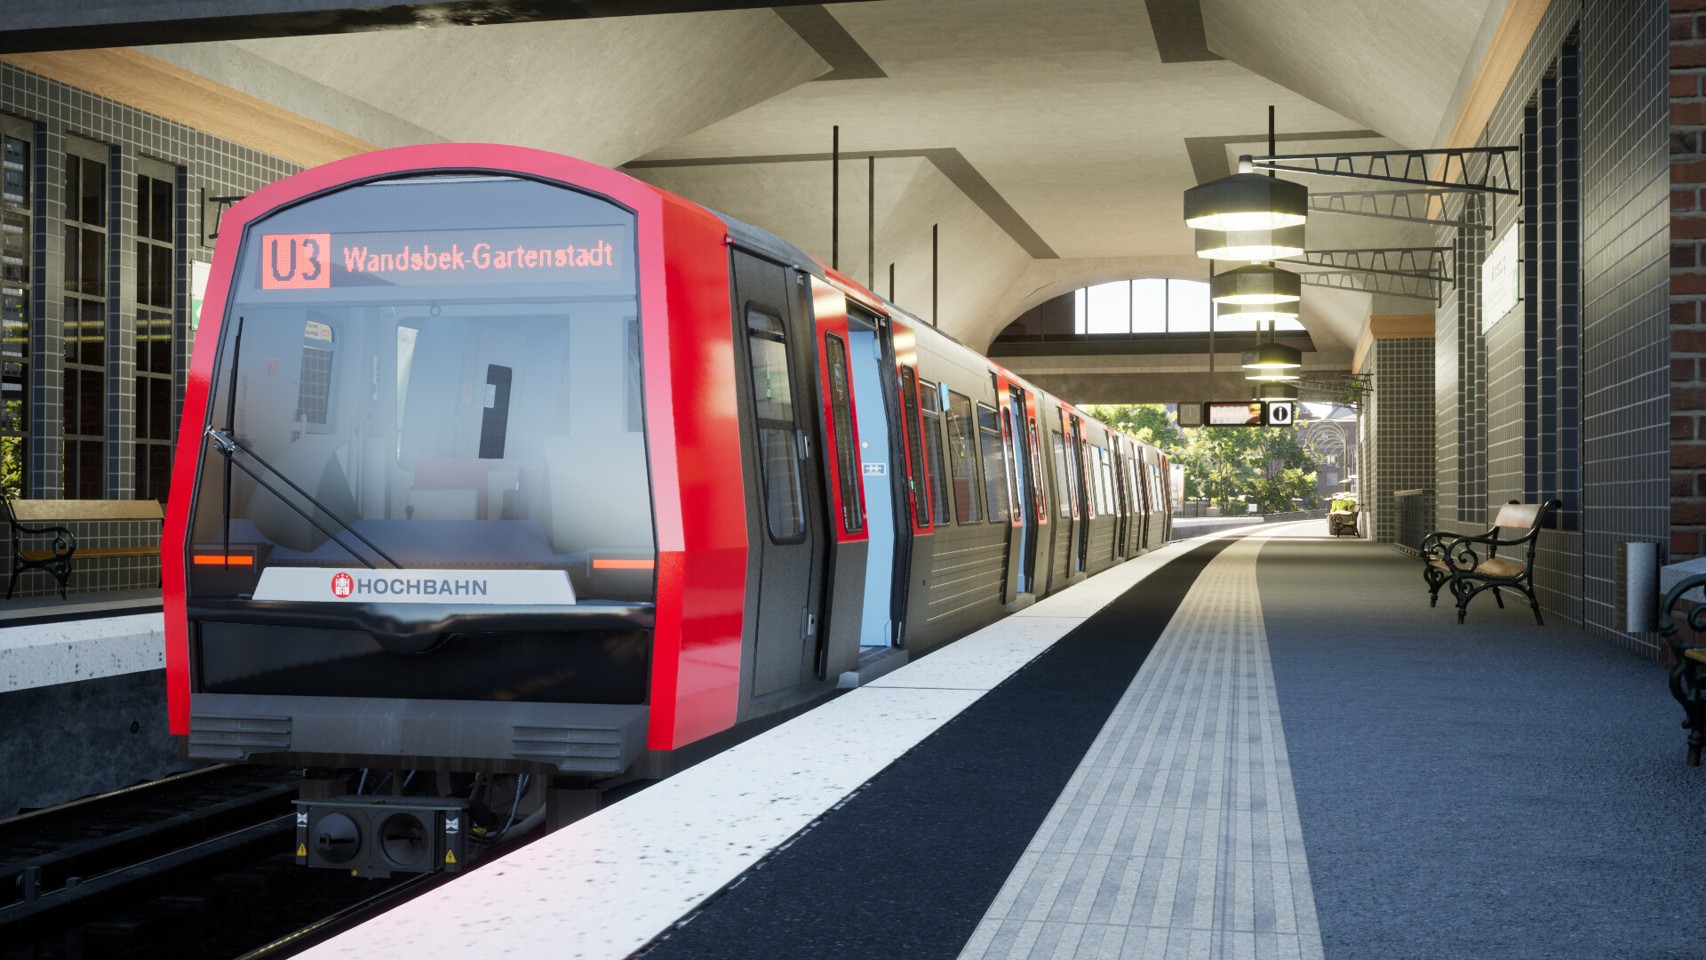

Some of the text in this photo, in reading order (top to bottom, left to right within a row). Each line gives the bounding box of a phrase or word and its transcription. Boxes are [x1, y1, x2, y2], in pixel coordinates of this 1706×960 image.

[272, 238, 614, 282] U3 Wandsbek-Gartenstadt
[357, 577, 488, 596] HOCHBAHN
